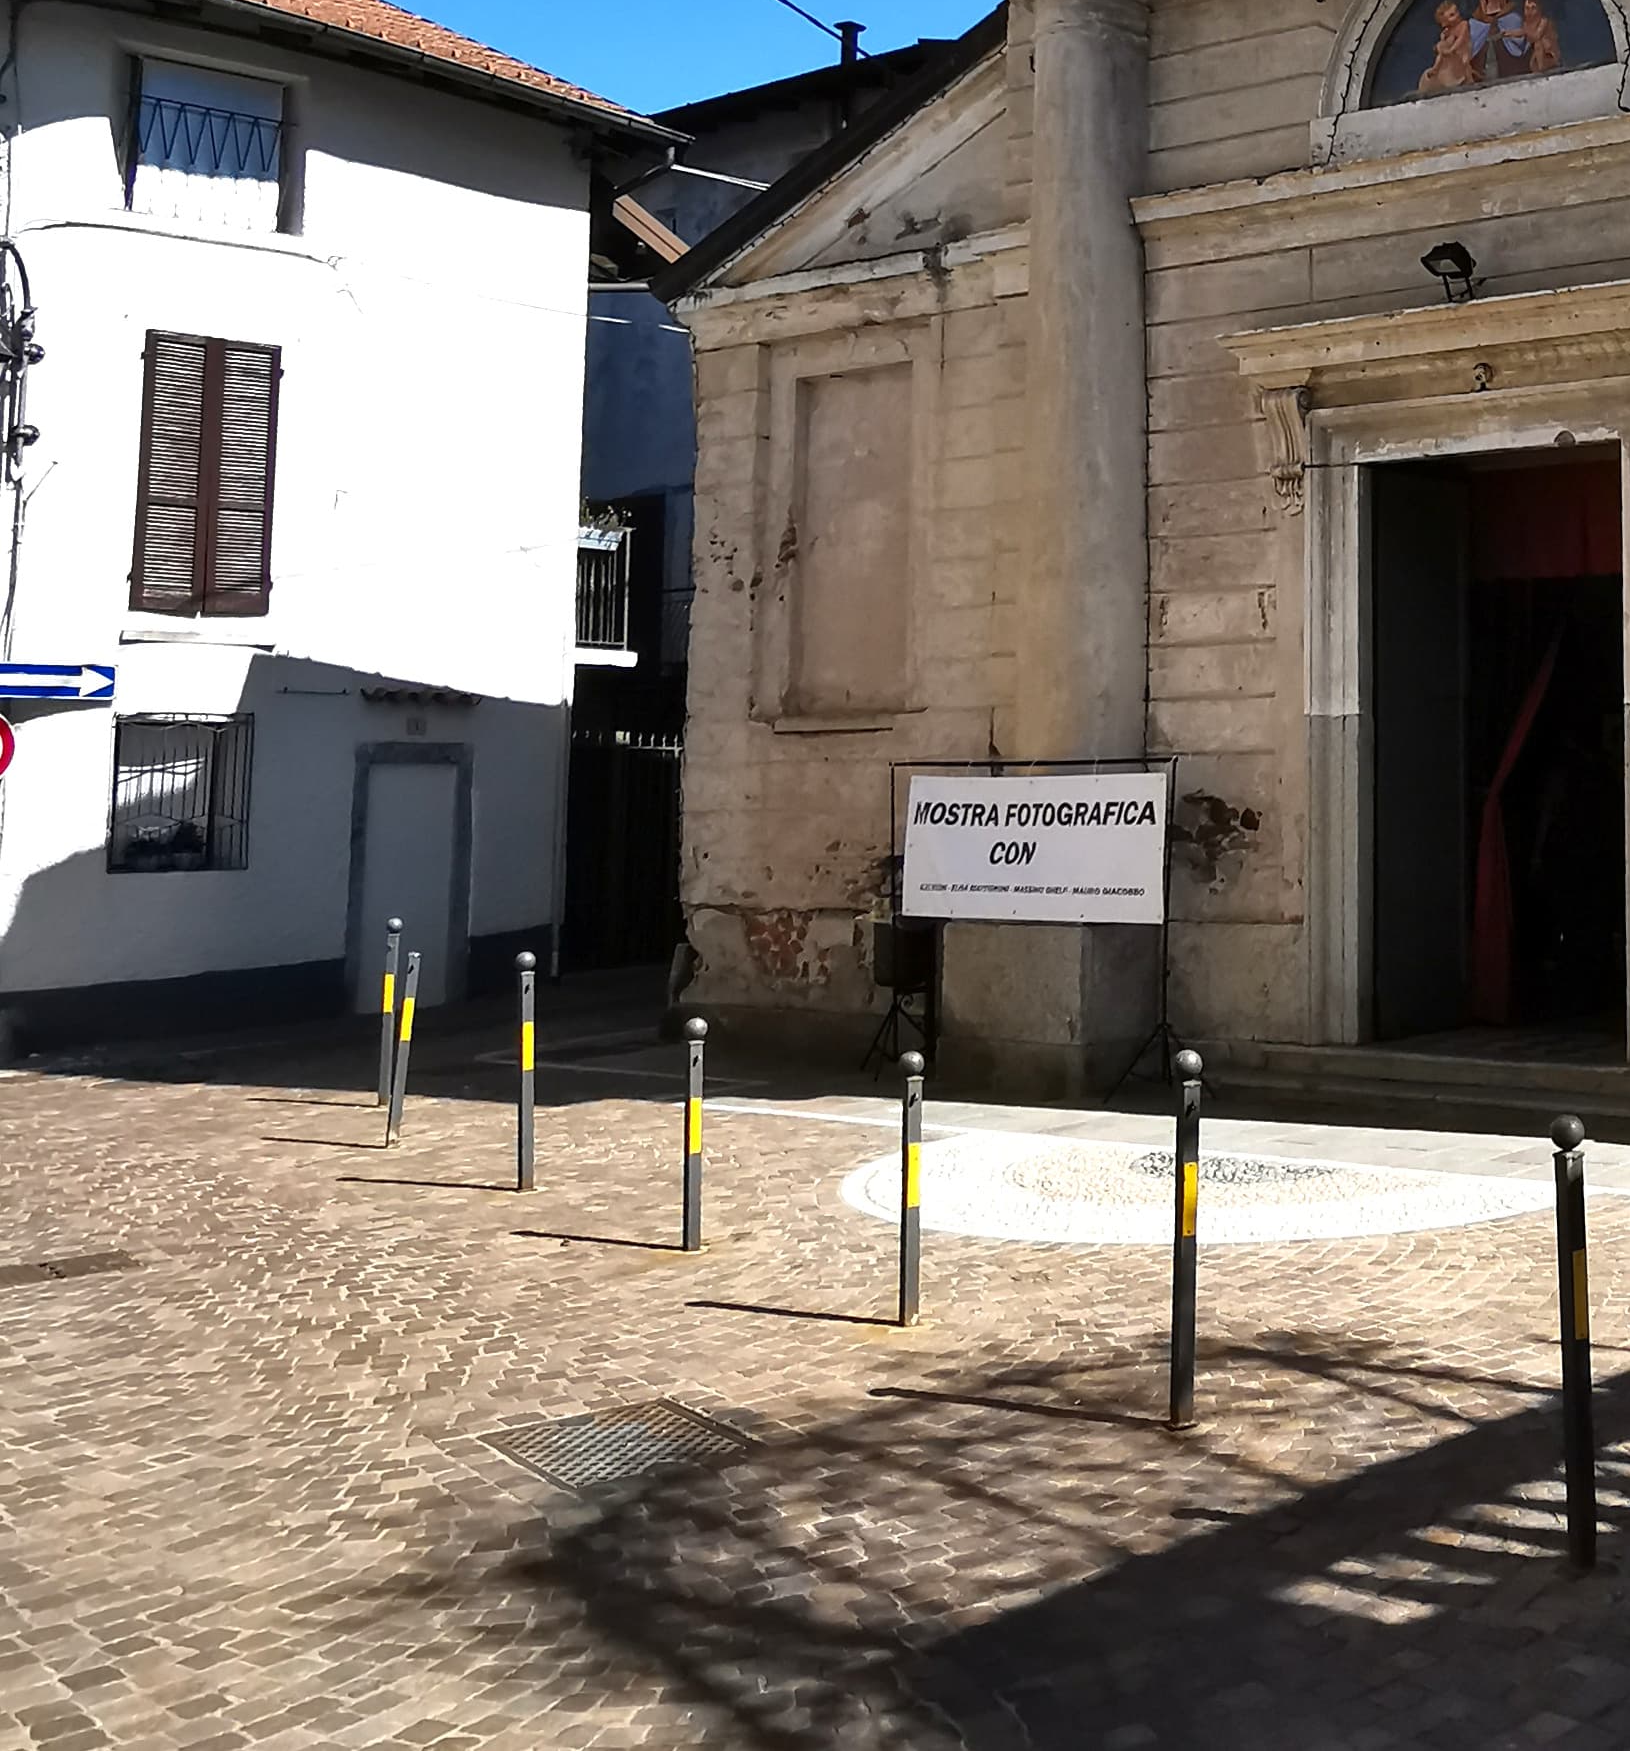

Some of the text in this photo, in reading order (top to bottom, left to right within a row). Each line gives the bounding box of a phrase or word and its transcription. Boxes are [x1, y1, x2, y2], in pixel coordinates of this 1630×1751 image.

[913, 801, 1157, 827] MOSTRA FOTOGRAFICA
[989, 841, 1037, 865] CON
